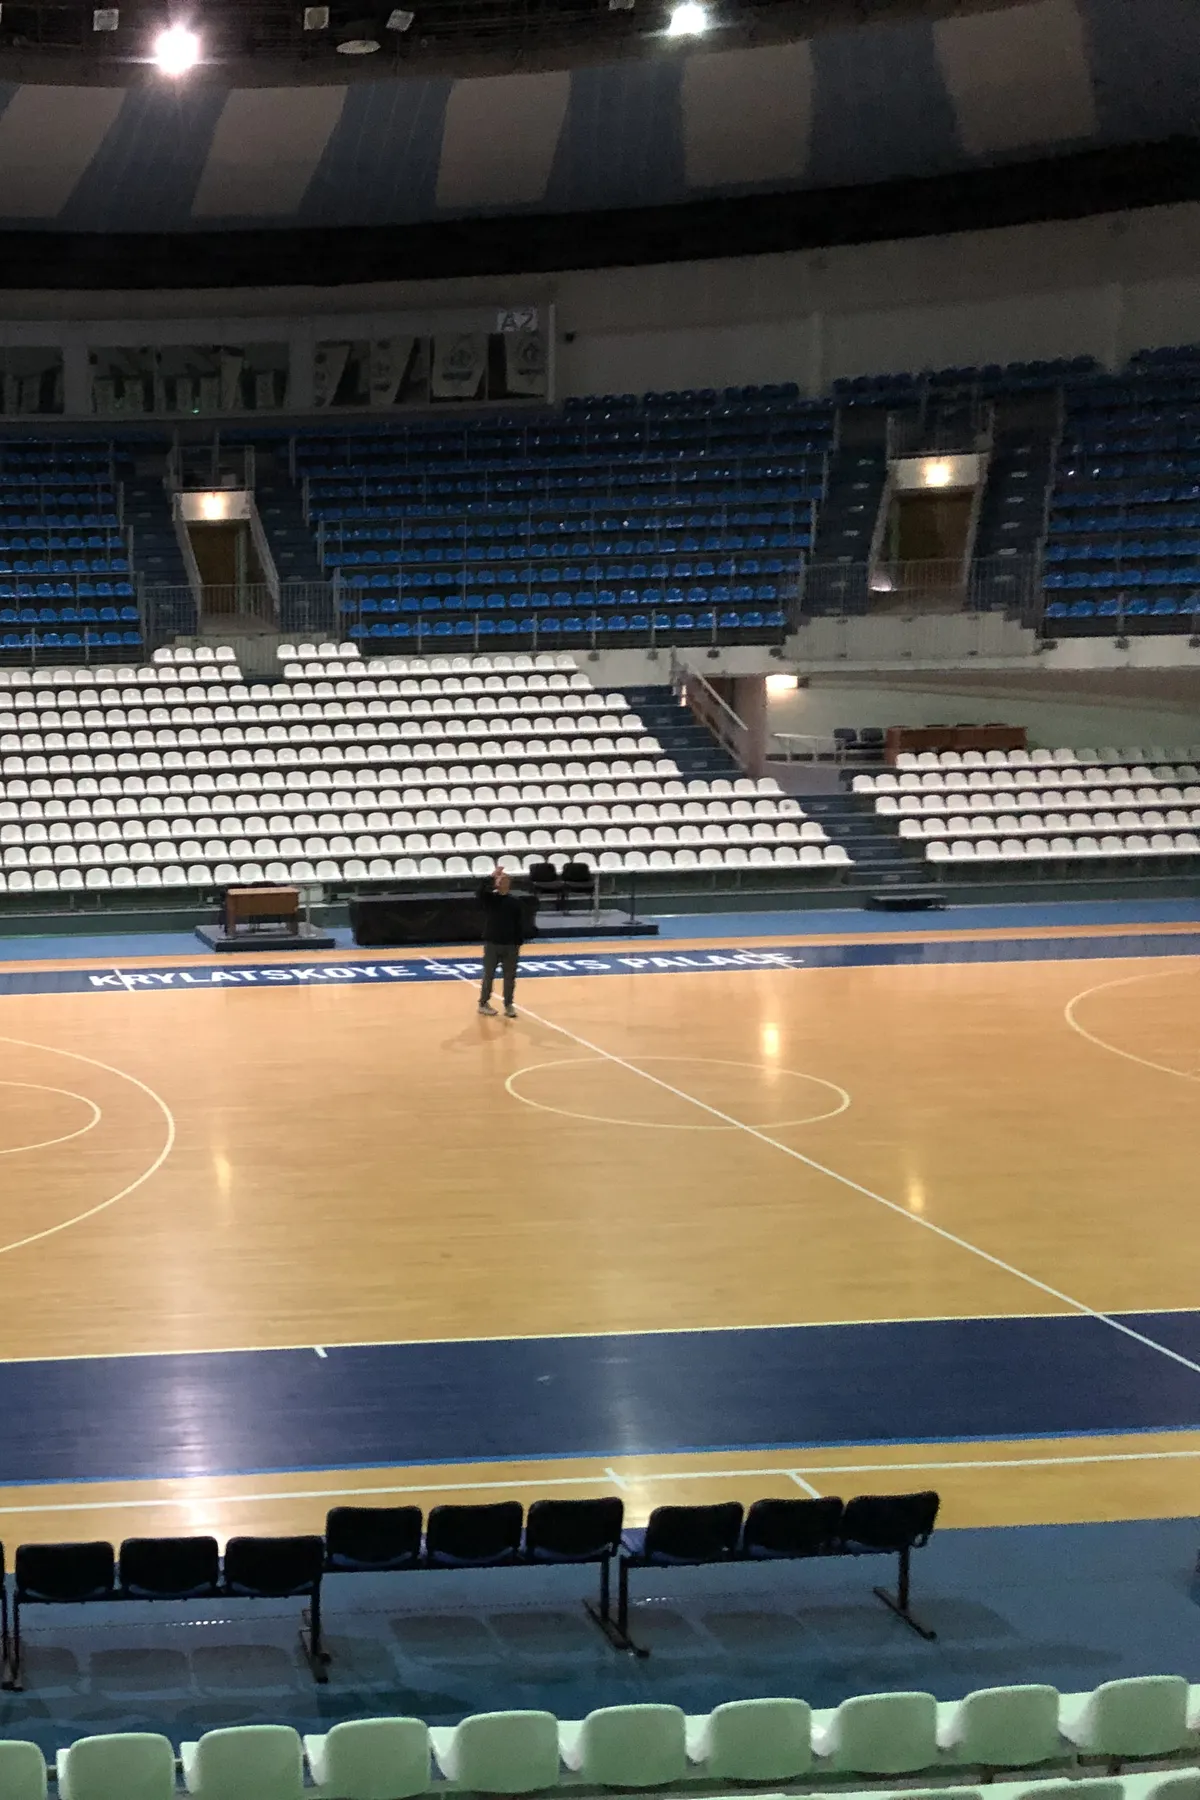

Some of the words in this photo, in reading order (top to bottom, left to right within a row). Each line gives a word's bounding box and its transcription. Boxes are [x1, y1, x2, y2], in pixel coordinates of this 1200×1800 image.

[500, 312, 535, 331] A2
[88, 964, 416, 987] KRYLATSKOYE
[616, 952, 804, 971] PALACE
